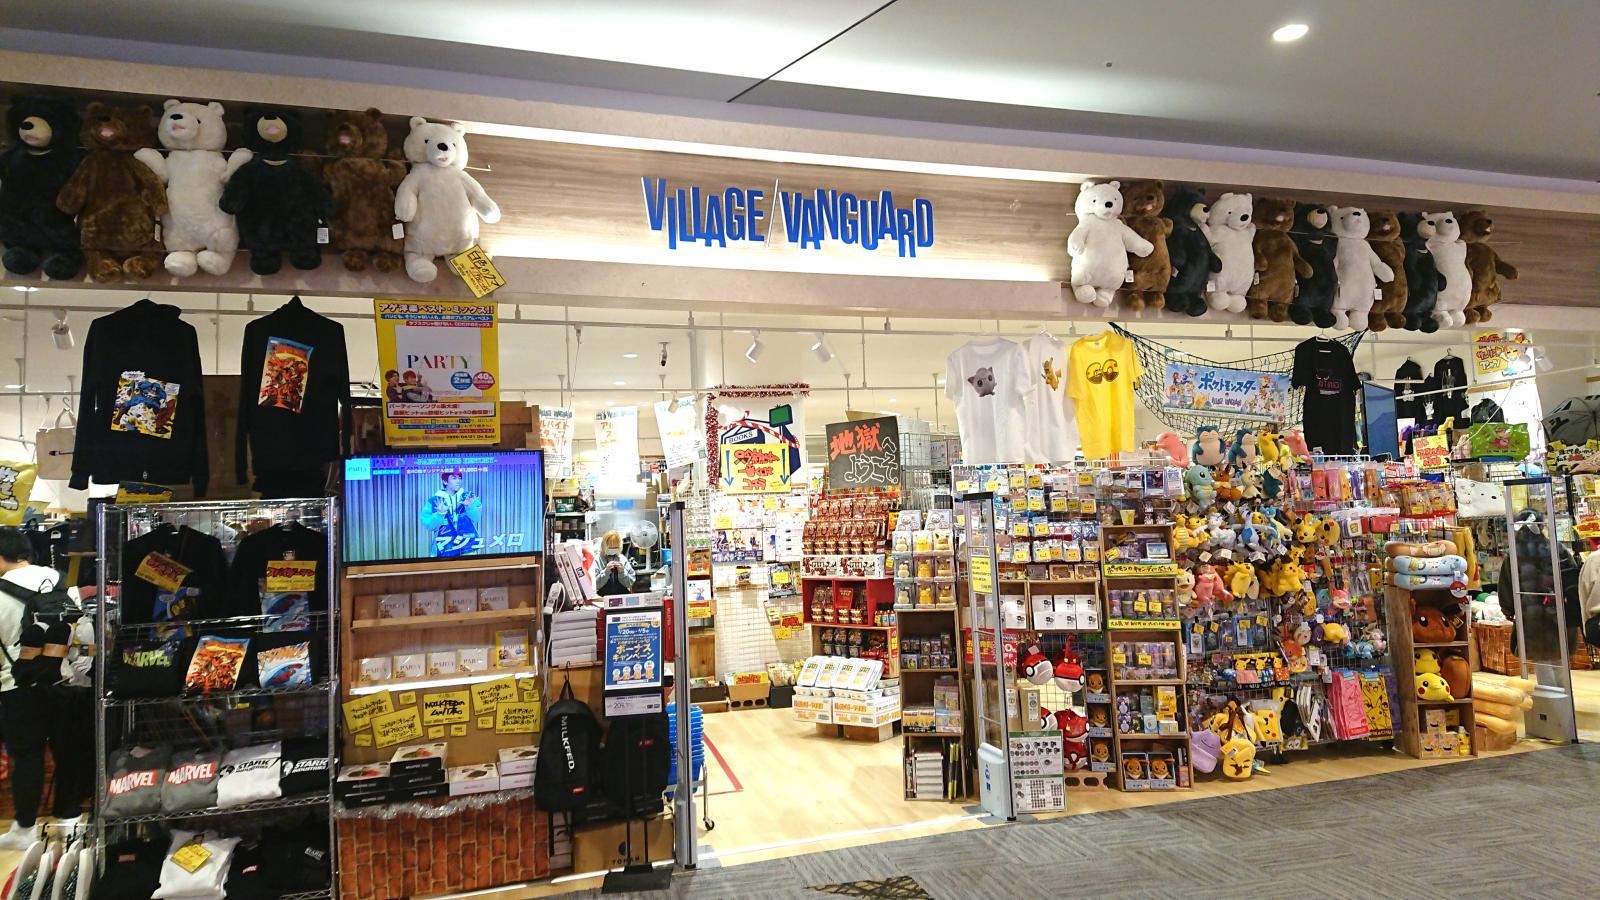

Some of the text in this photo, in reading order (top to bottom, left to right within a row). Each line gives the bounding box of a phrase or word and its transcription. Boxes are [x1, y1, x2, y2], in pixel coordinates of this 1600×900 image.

[640, 176, 934, 258] VILLAGE VANGUARD
[408, 354, 468, 369] PARTY
[1198, 371, 1257, 395] ポケットモンスター
[728, 431, 753, 444] BOOKS
[122, 650, 171, 668] MARVEL
[168, 763, 214, 784] MARVEL
[238, 760, 270, 769] STARK
[294, 760, 328, 769] STARK
[110, 772, 156, 794] MARVEL
